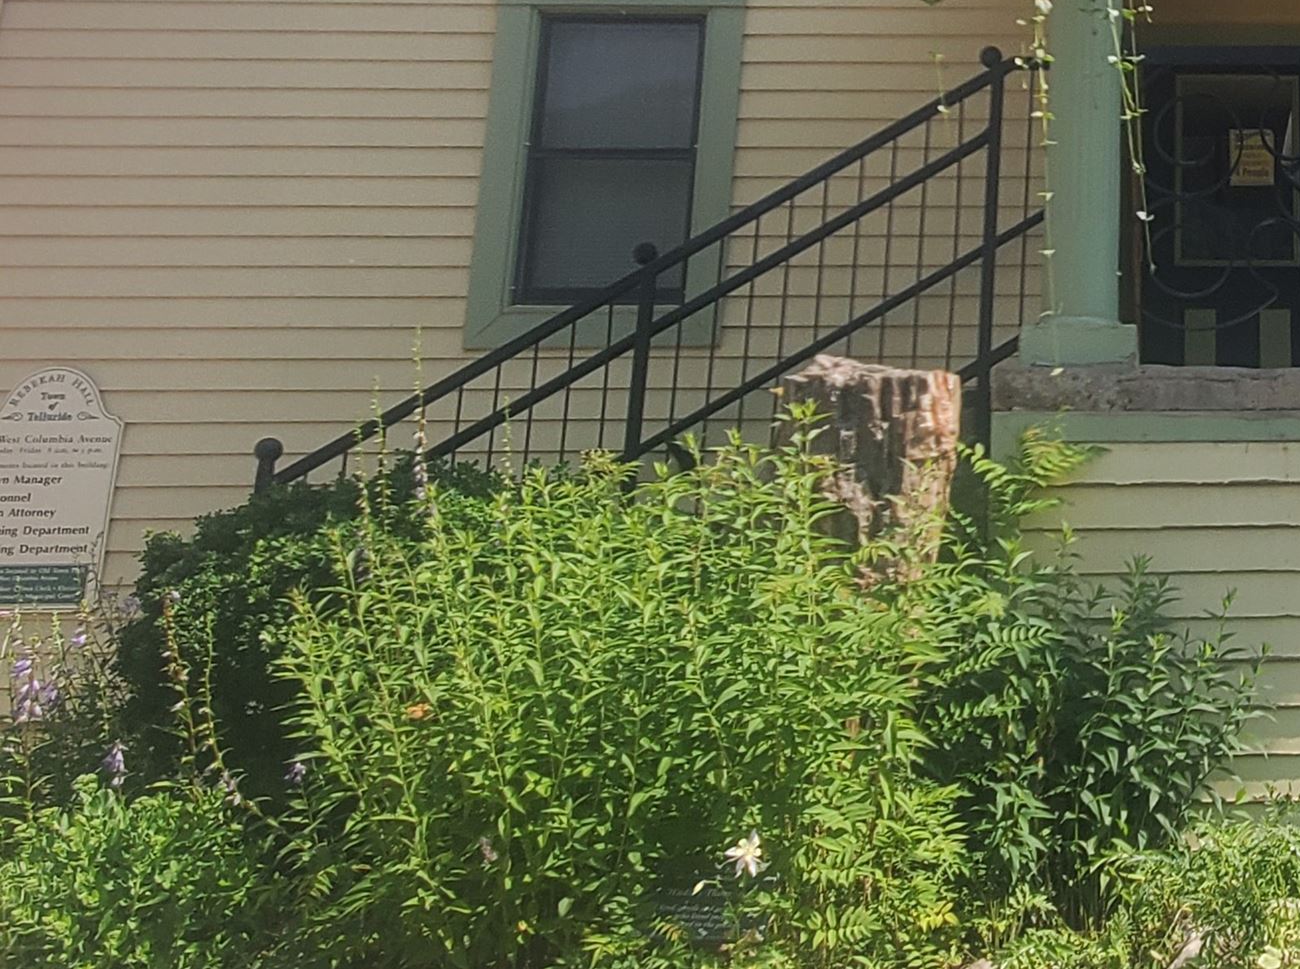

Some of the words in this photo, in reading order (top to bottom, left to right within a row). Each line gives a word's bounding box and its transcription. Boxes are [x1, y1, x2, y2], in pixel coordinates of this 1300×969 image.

[9, 374, 66, 407] REBEKAH
[71, 378, 94, 406] HALL
[40, 392, 66, 401] Town
[48, 401, 60, 411] of
[27, 412, 73, 422] Telluride
[25, 434, 73, 444] Columbia
[77, 434, 113, 444] Avenue
[14, 475, 62, 486] Manager
[0, 493, 31, 502] onnel
[8, 508, 56, 520] Attorney
[23, 526, 89, 537] Department
[20, 544, 88, 556] Department
